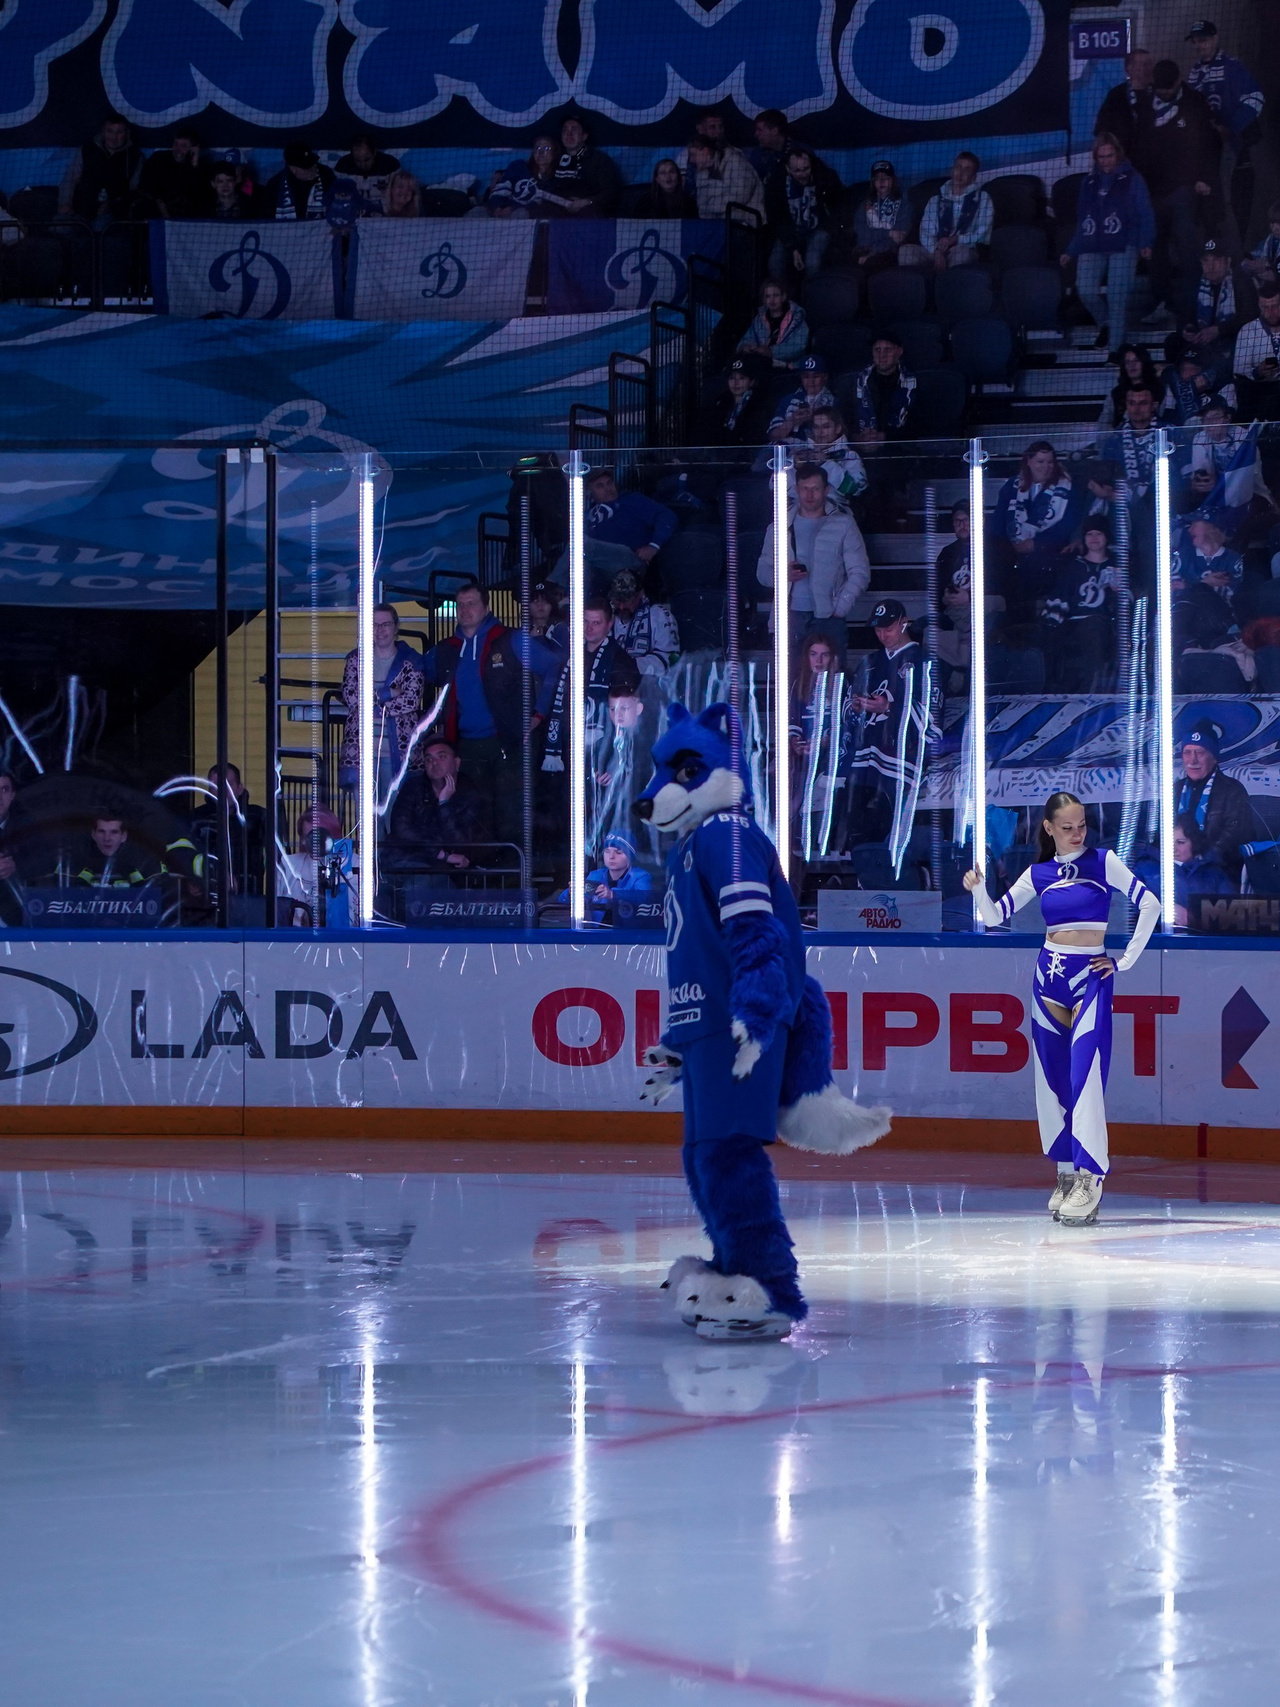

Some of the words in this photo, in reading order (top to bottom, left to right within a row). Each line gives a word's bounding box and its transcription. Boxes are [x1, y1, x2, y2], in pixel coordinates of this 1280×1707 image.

[1093, 30, 1120, 48] 105
[717, 813, 751, 830] ВТБ
[62, 899, 145, 916] БАЛТИКА
[443, 901, 524, 918] БАЛТИКА
[858, 908, 887, 918] АВТО
[866, 918, 902, 929] РАДИО
[130, 989, 418, 1061] LADA
